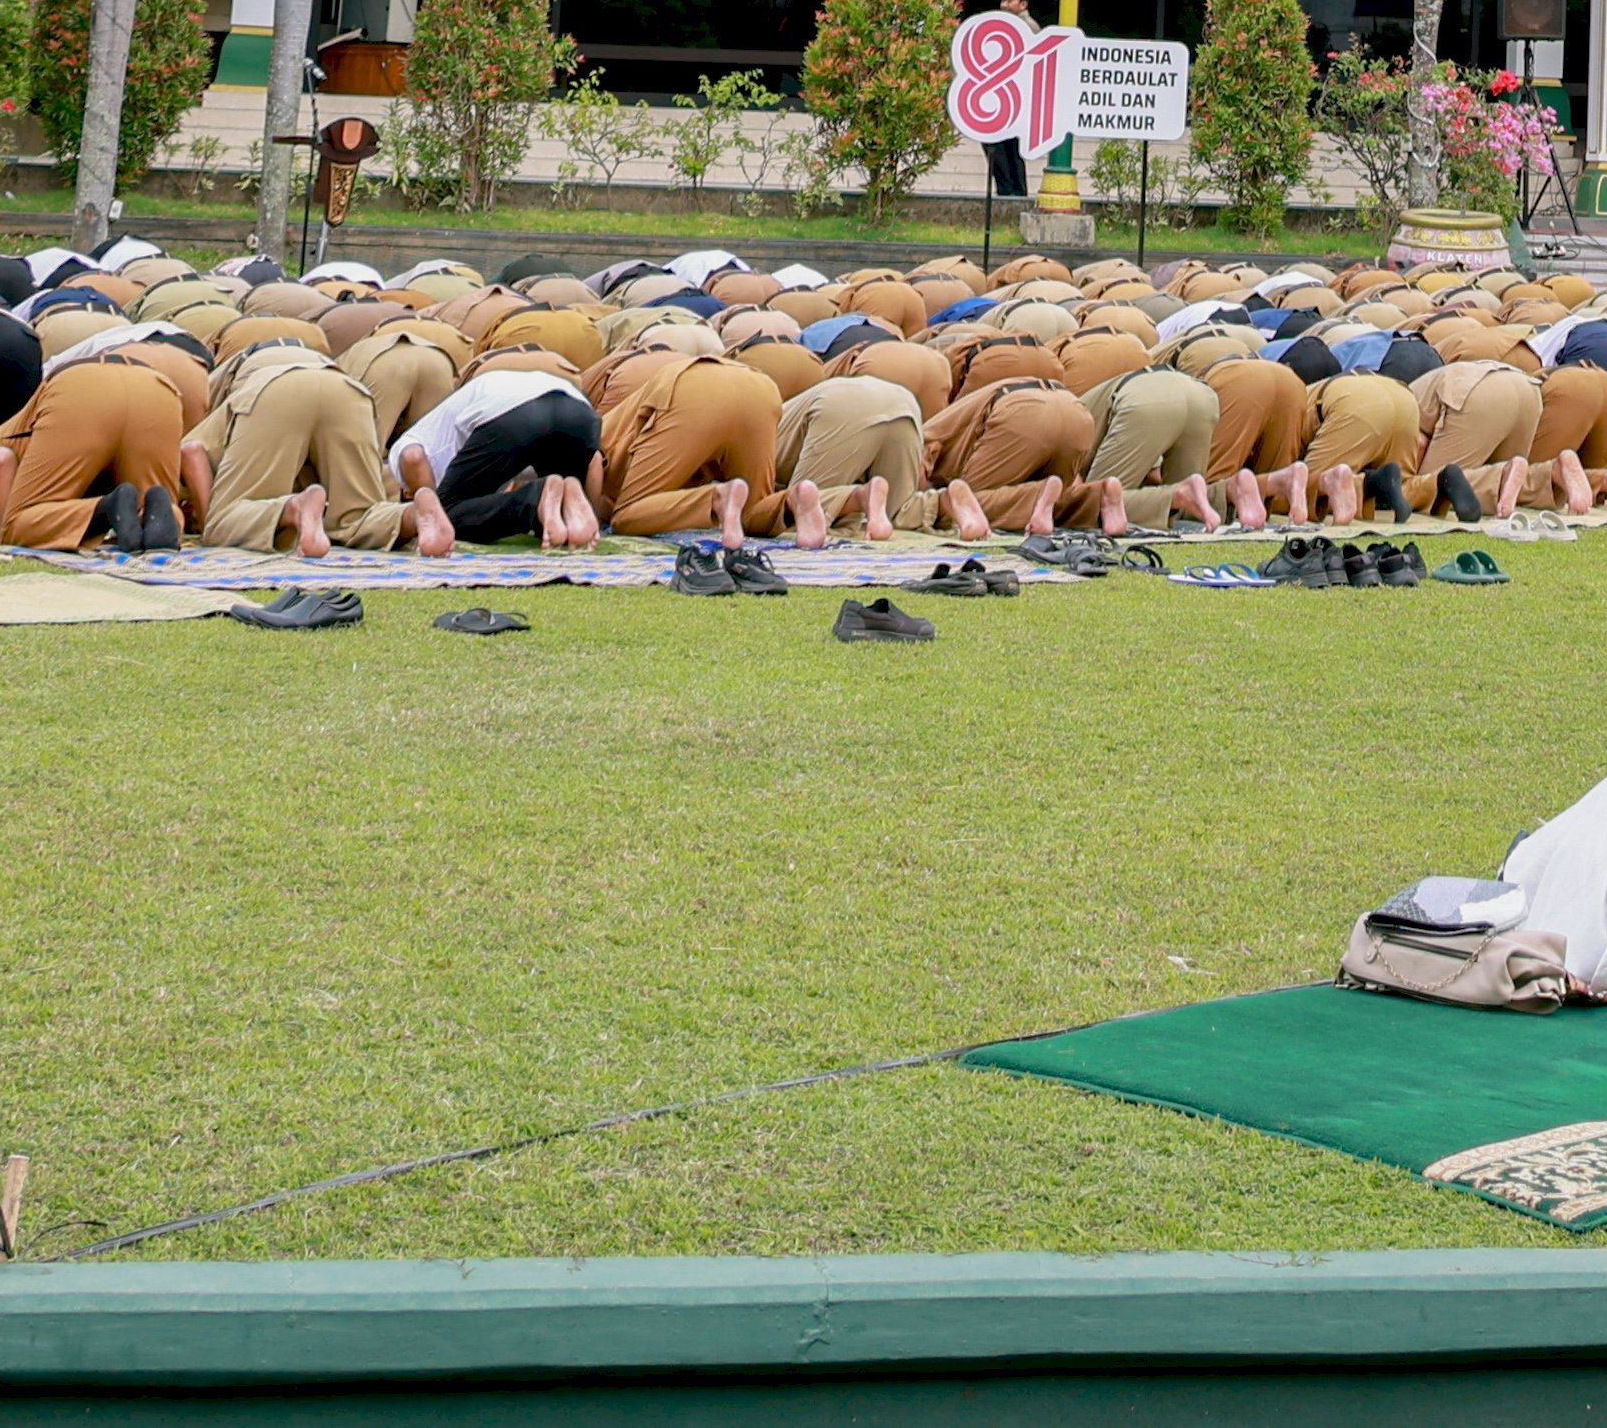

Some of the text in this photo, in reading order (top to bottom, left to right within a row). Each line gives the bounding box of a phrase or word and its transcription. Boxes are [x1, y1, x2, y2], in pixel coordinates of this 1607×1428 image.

[1081, 47, 1172, 65] INDONESIA
[957, 19, 1071, 152] 81
[1080, 69, 1178, 87] BERDAULAT
[1078, 91, 1156, 108] ADIL DAN
[1077, 113, 1155, 131] MAKMUR
[1427, 251, 1483, 263] KLATEN
